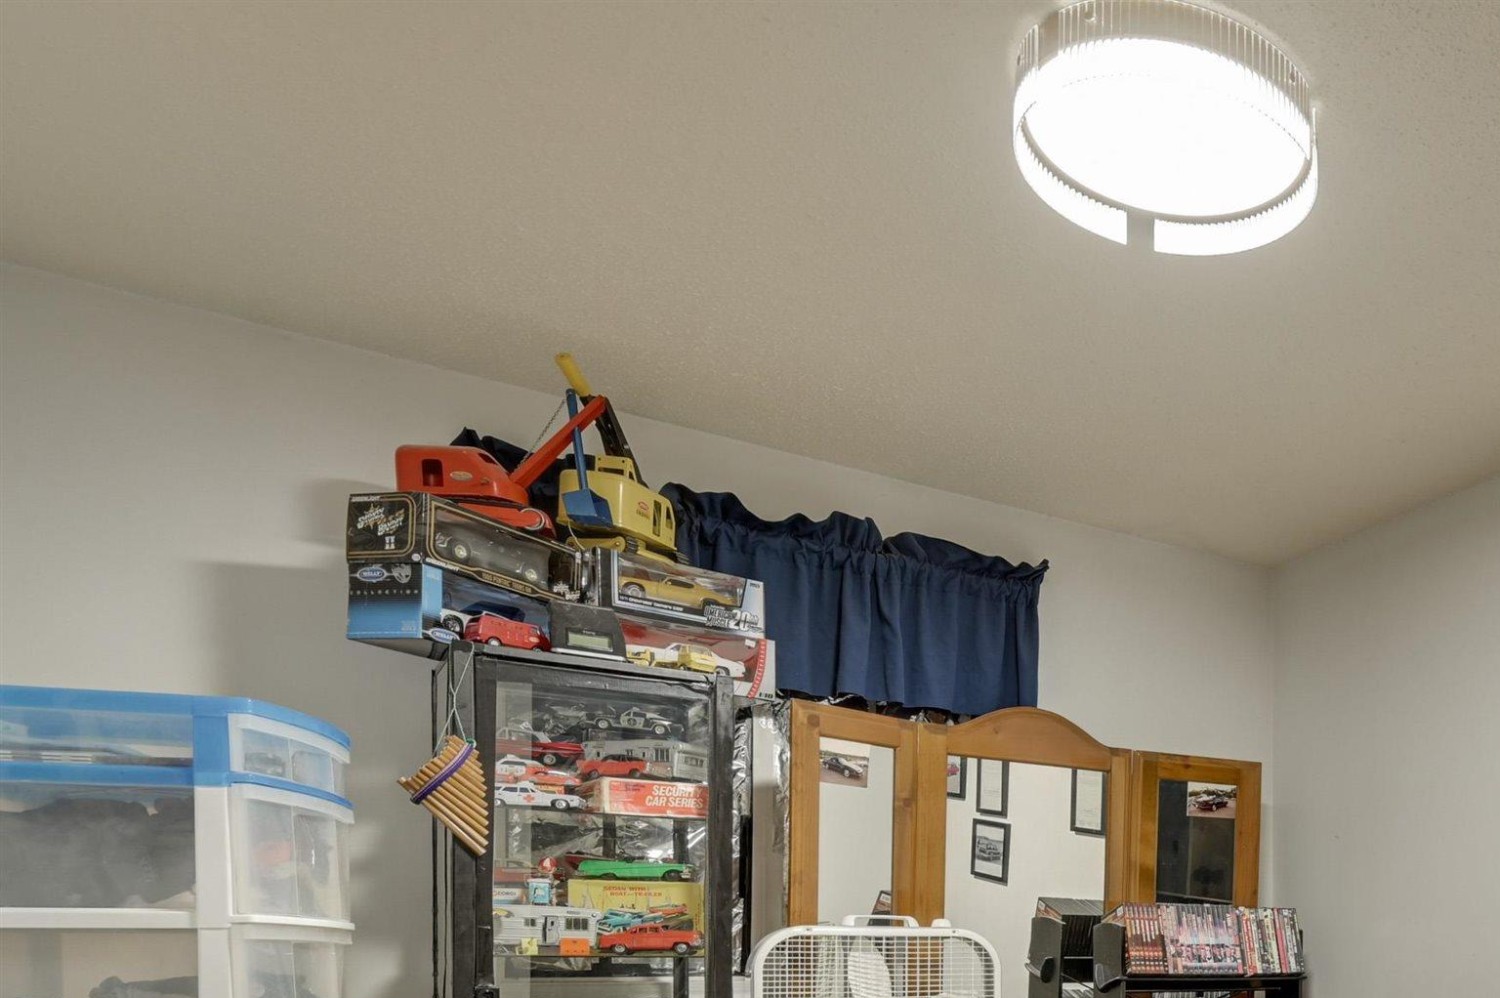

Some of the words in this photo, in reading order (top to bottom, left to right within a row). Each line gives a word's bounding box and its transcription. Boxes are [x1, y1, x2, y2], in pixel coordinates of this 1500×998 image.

[651, 784, 702, 799] SECURITY
[645, 795, 668, 808] CAR
[668, 796, 704, 810] SERIES
